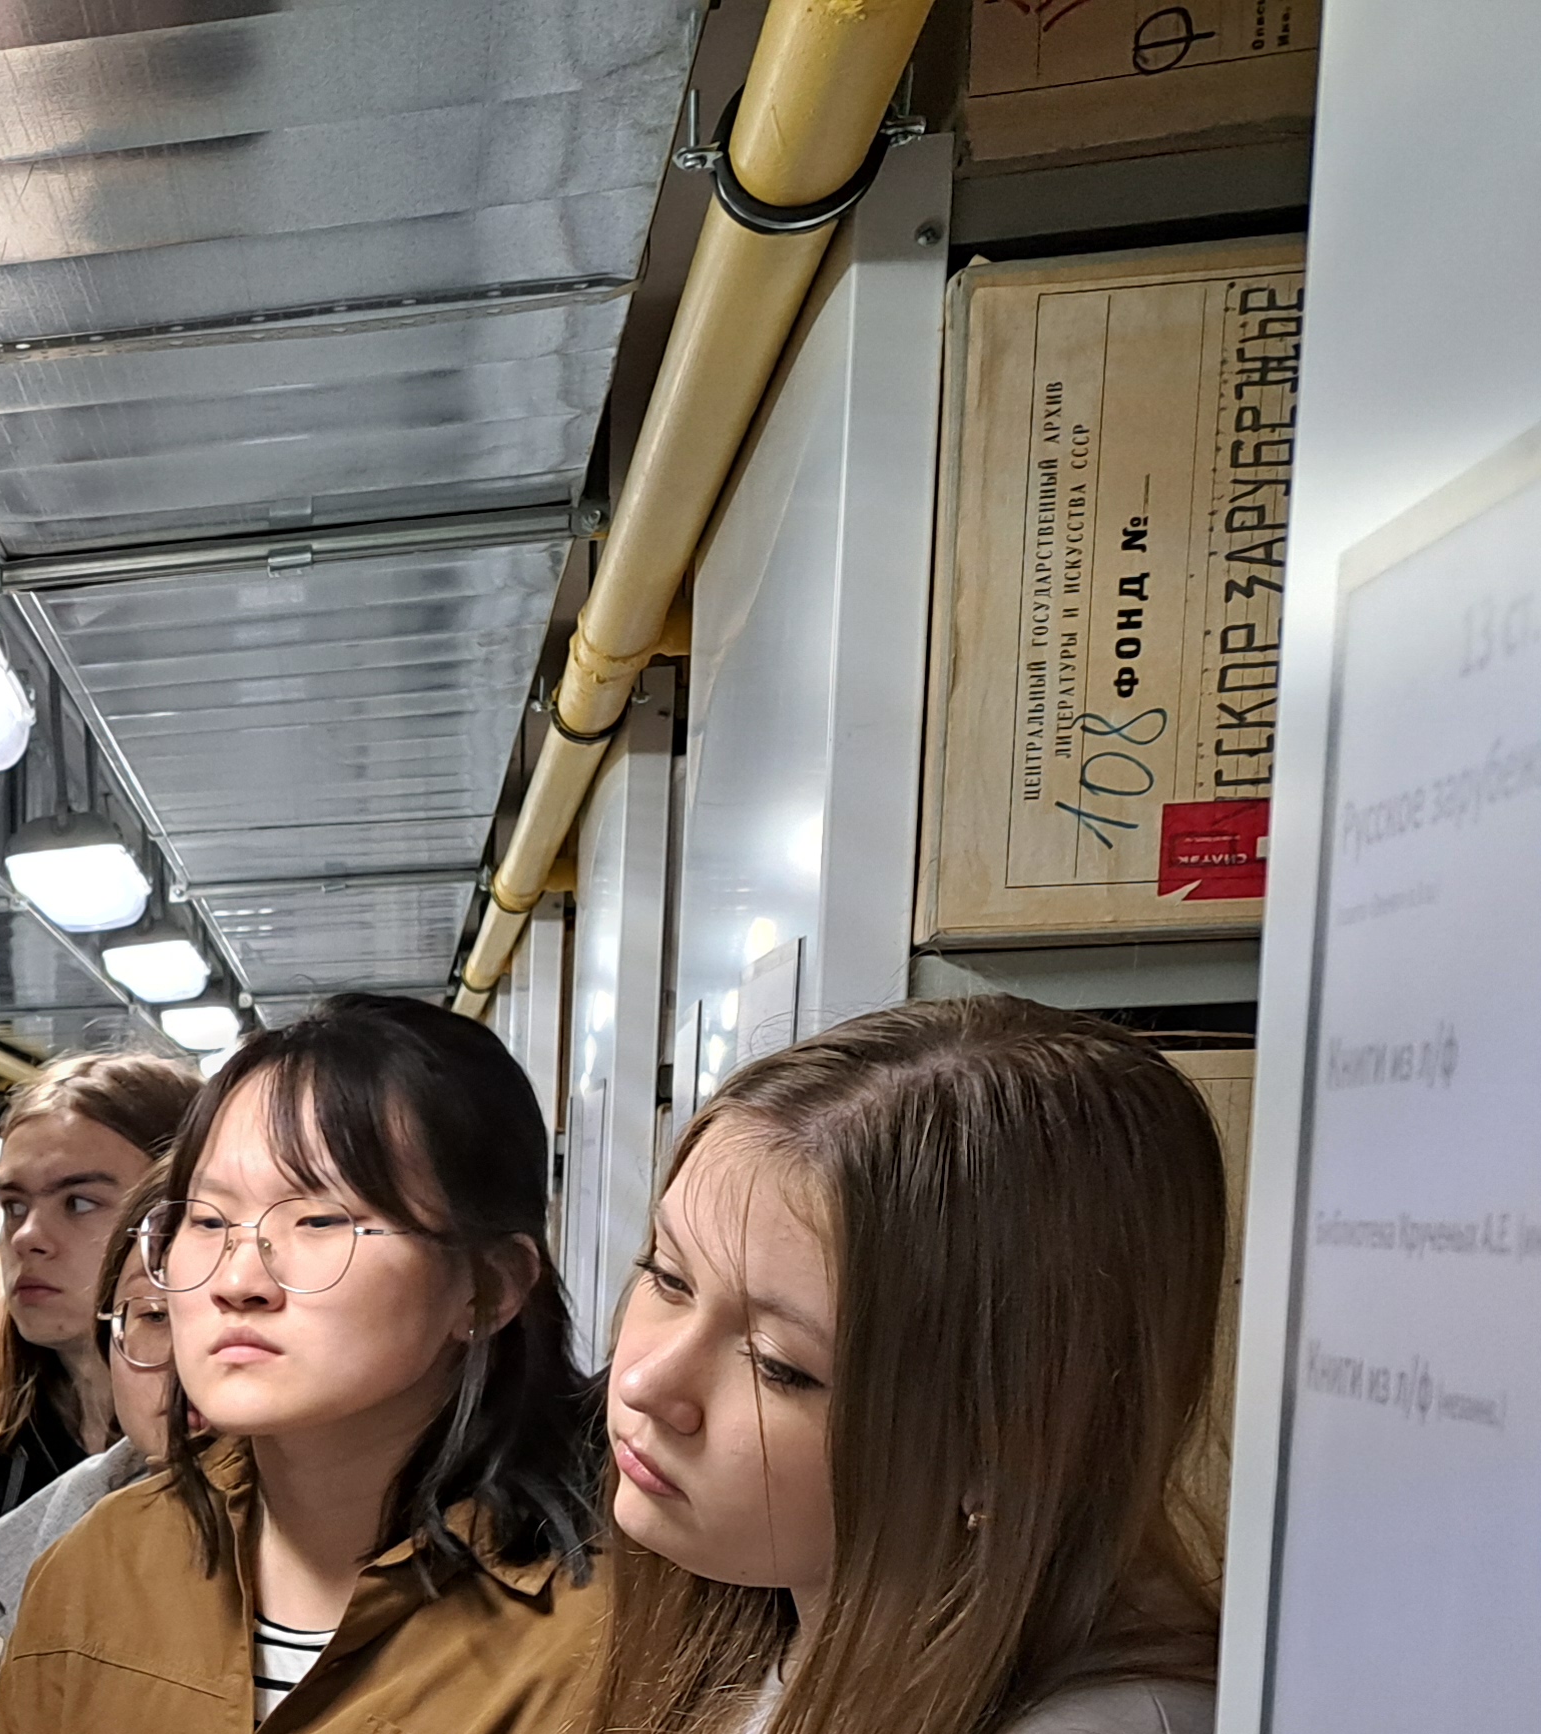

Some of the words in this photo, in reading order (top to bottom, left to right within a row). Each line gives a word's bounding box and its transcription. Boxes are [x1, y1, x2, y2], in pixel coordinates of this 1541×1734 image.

[1043, 381, 1064, 445] АРХИВ
[1070, 424, 1091, 470] СССР
[1031, 457, 1058, 648] ГОСУДАРСТВЕННЫЙ
[1063, 483, 1087, 594] ИСКУССТВА
[1062, 607, 1080, 619] И
[1113, 572, 1151, 699] ФОНД
[1023, 660, 1047, 801] ЦЕНТРАЛЬНЫЙ
[1054, 632, 1079, 759] ЛИТЕРАТУРЫ
[1054, 707, 1168, 850] 108
